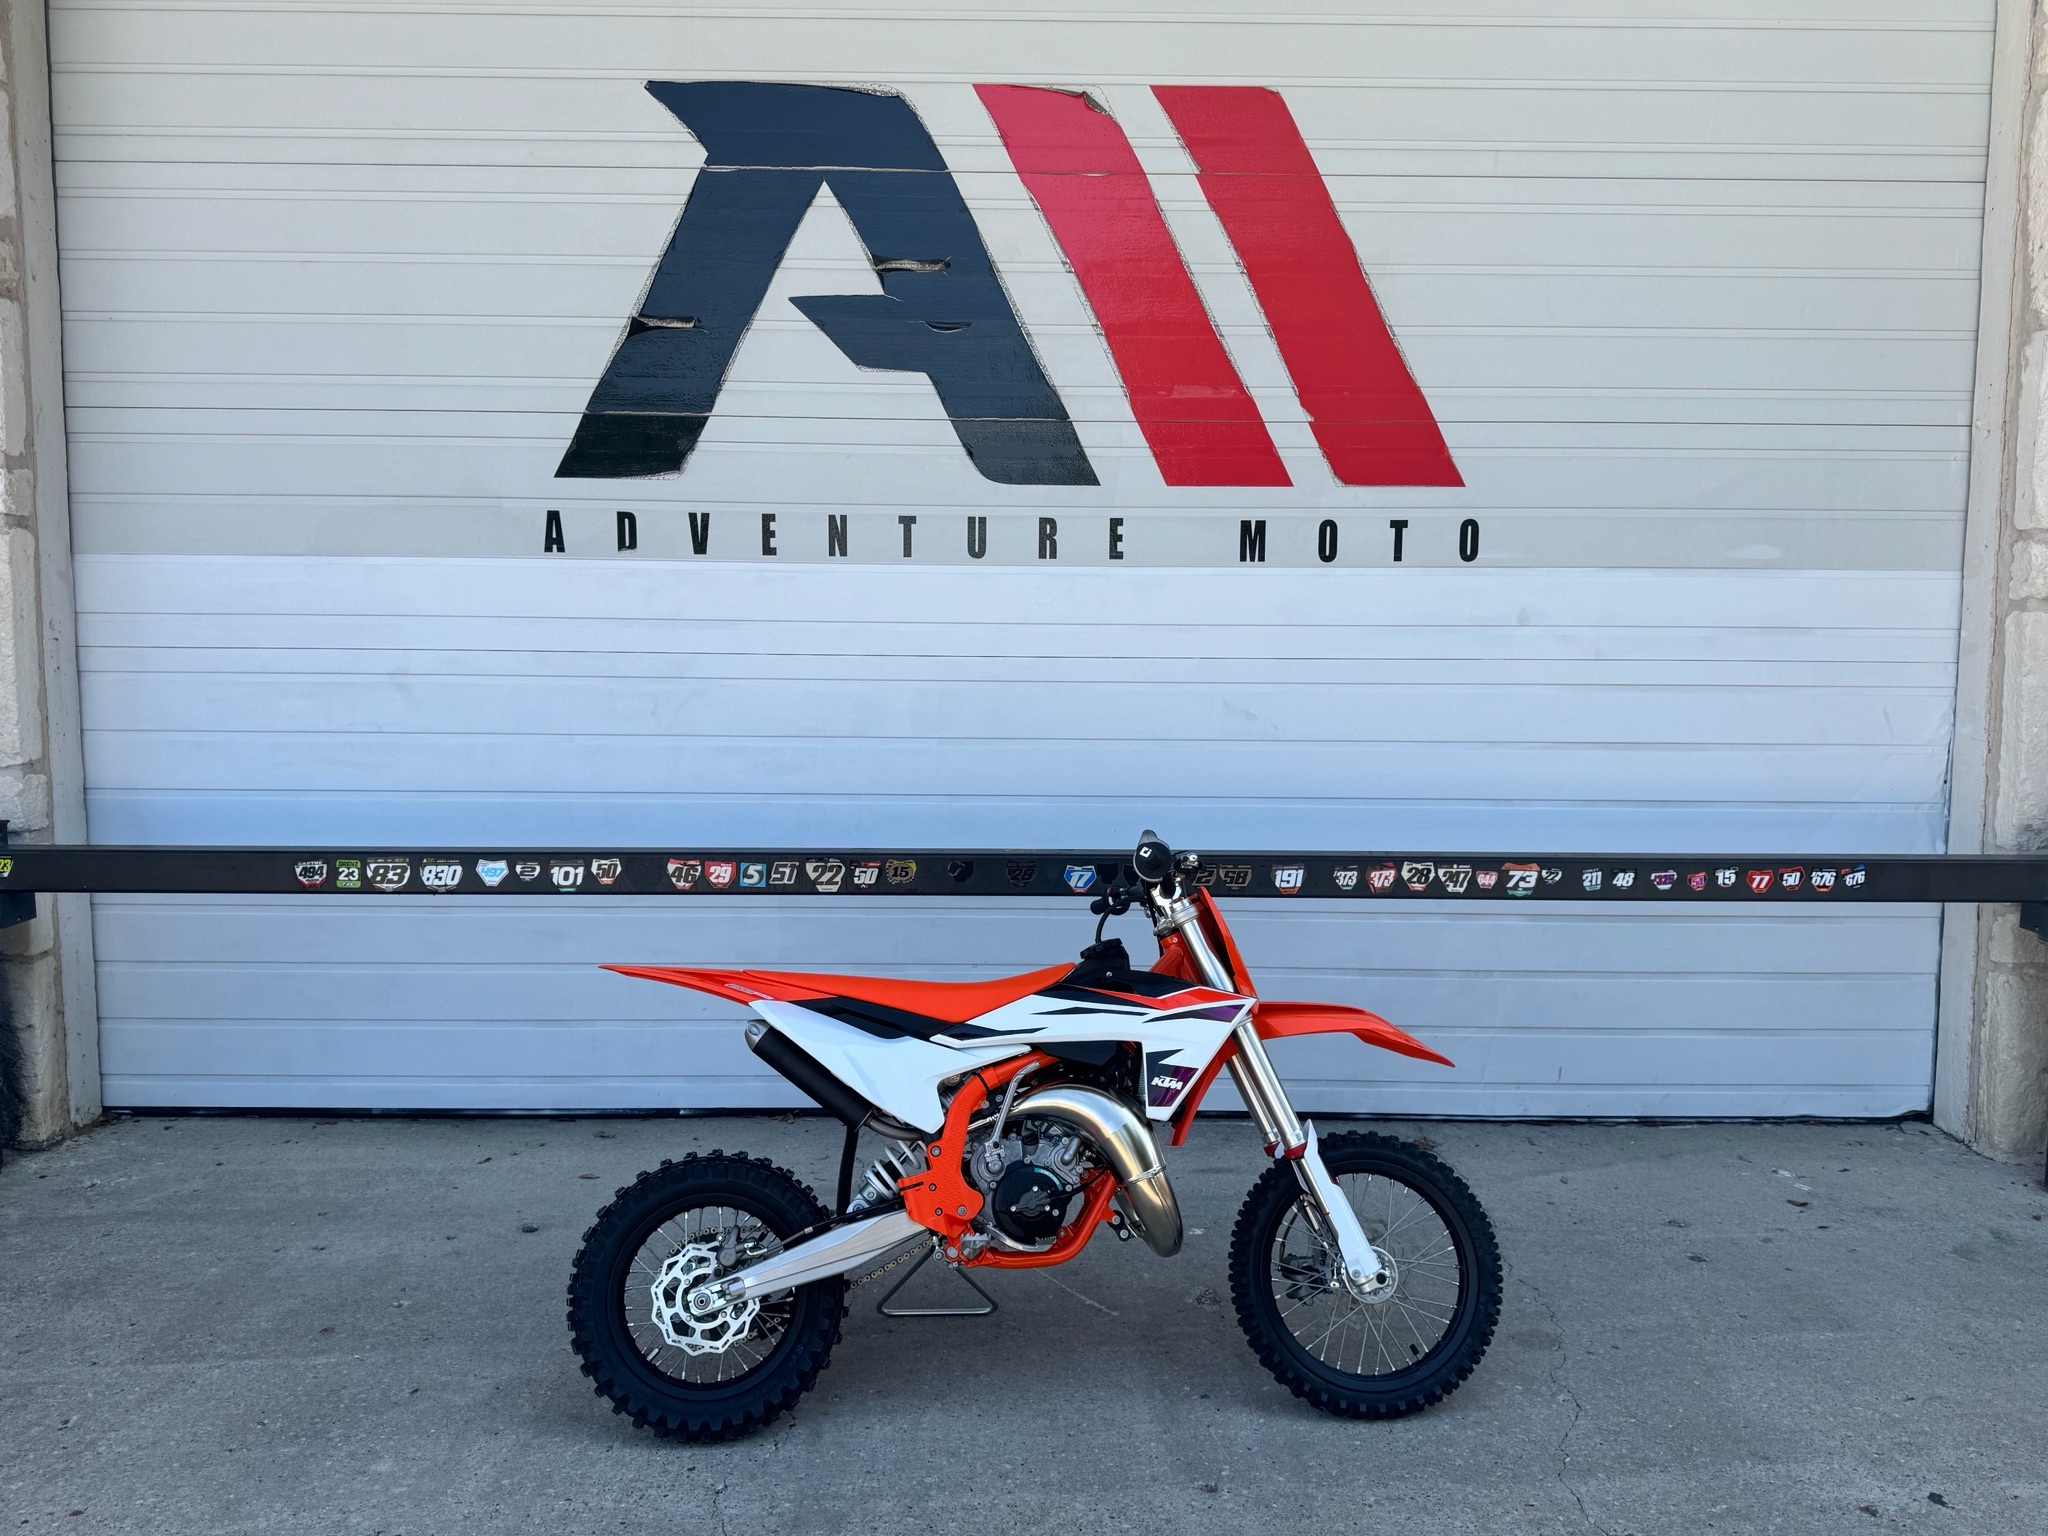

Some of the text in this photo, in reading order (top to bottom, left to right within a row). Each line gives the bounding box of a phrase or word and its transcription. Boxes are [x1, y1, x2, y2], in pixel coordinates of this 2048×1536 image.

[544, 509, 1480, 562] ADVENTURE MOTO
[299, 866, 324, 879] 494
[338, 867, 359, 881] 23
[370, 865, 408, 885] 83
[422, 865, 463, 886] 830
[519, 866, 536, 877] 2
[550, 866, 584, 886] 101
[596, 863, 616, 879] 50
[670, 866, 699, 884] 46
[709, 865, 732, 883] 29
[743, 864, 763, 885] 5
[812, 864, 843, 885] 22
[853, 867, 879, 884] 50
[891, 866, 910, 878] 15
[1224, 870, 1249, 885] 58
[1275, 869, 1304, 888] 191
[1405, 867, 1432, 885] 28
[1442, 870, 1470, 889] 247
[1506, 871, 1538, 888] 73
[1582, 871, 1602, 887] 211
[1612, 872, 1635, 887] 48
[1715, 870, 1736, 886] 15
[1782, 872, 1800, 887] 50
[1751, 875, 1770, 888] 77
[1151, 1075, 1183, 1090] KTM
